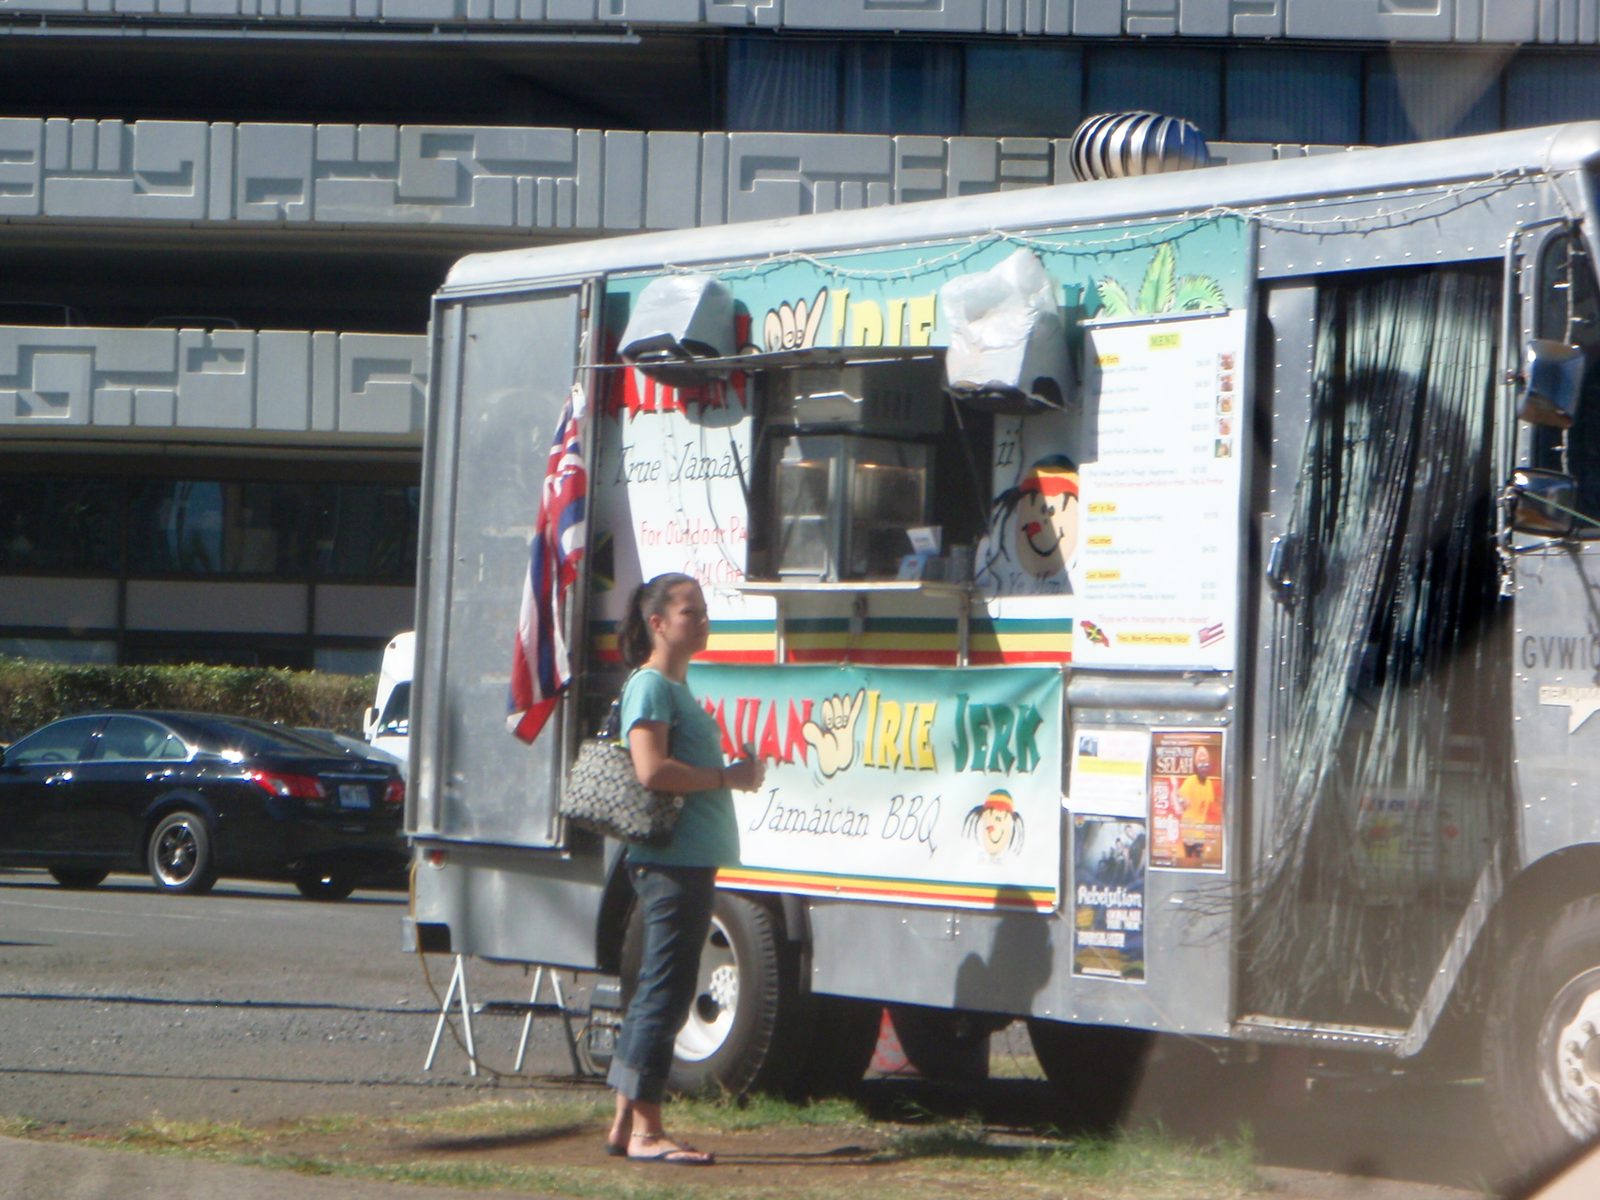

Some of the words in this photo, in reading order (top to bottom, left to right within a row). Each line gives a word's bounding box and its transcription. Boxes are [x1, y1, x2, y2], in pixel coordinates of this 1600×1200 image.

[612, 444, 662, 487] True
[668, 441, 750, 483] Jamaic
[863, 689, 940, 774] IRIE
[951, 692, 1044, 777] JERK
[749, 787, 870, 838] Jamaican
[881, 794, 942, 859] BBQ
